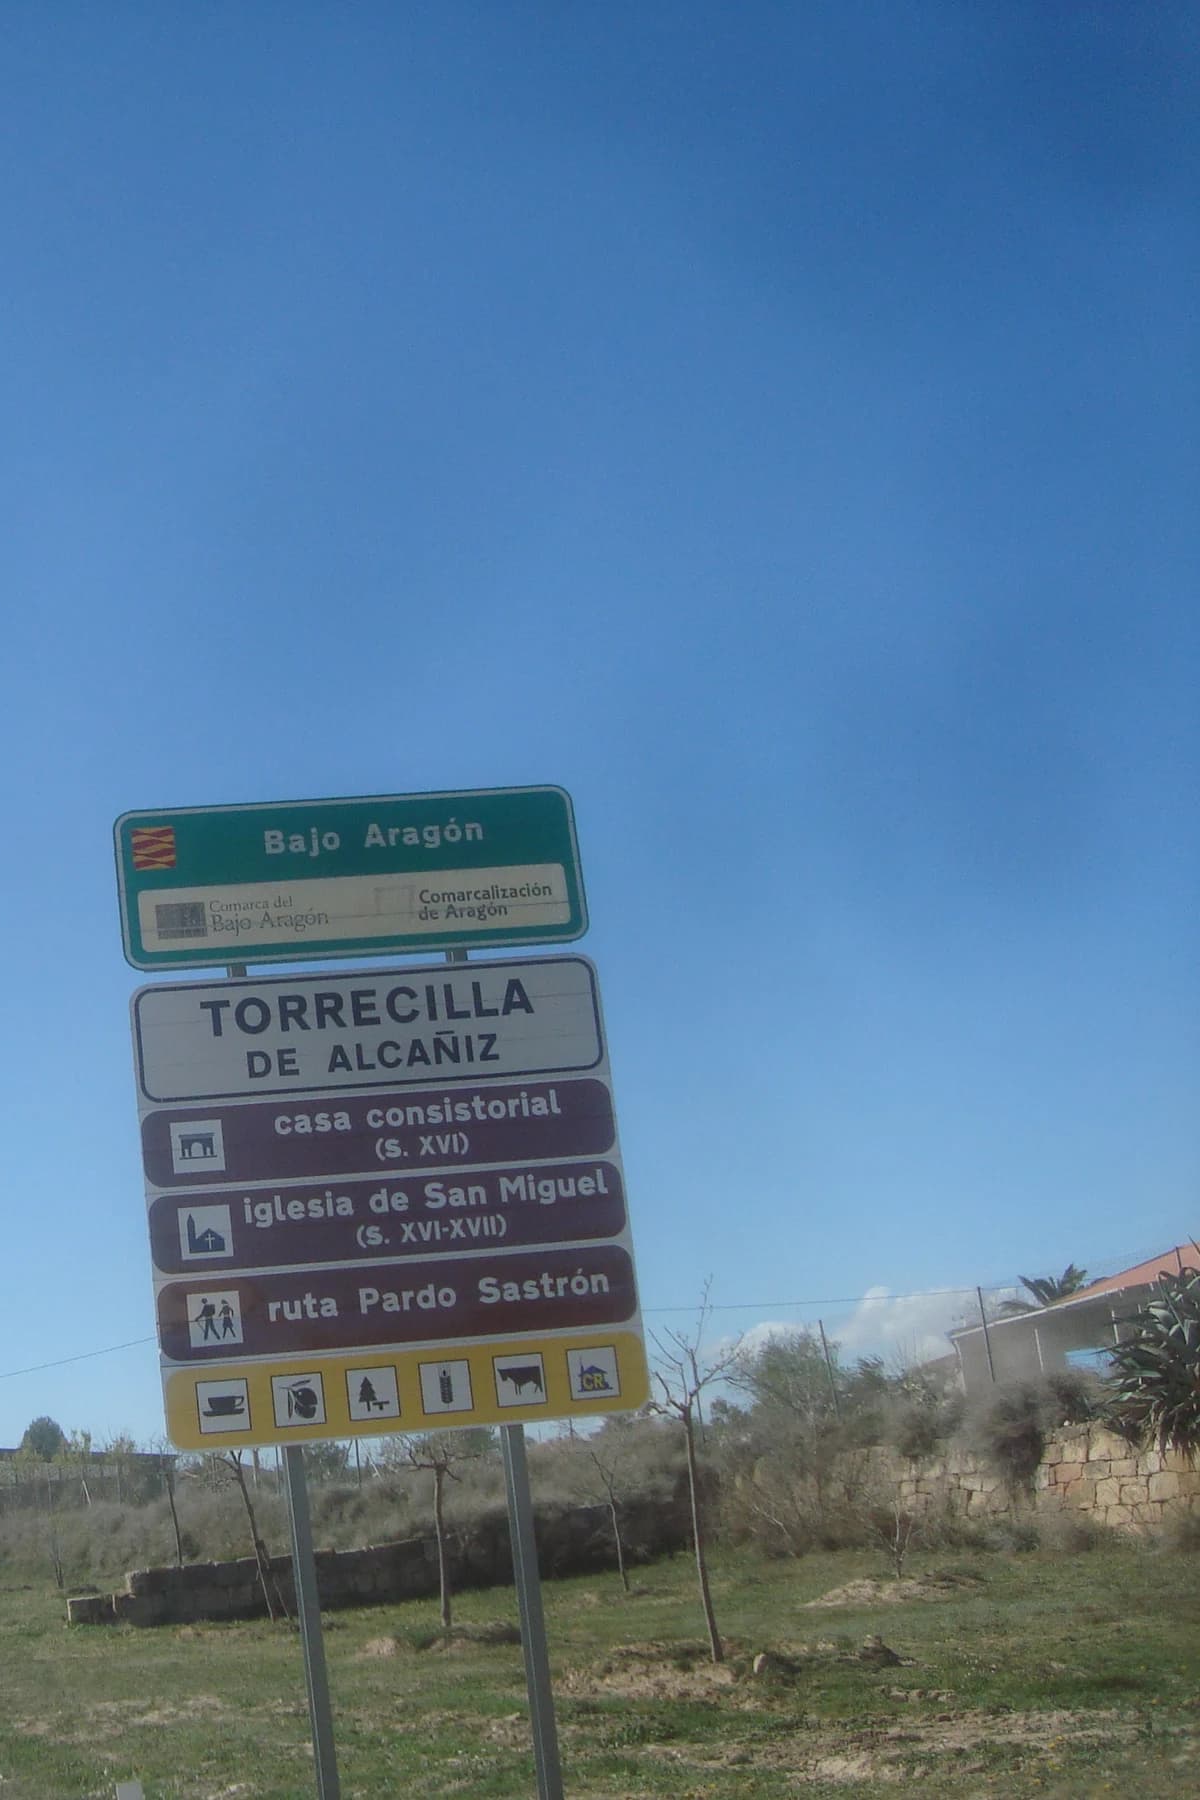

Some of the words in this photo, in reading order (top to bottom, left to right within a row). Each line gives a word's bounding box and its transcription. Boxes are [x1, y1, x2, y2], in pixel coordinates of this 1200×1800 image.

[263, 829, 341, 857] Bajo
[364, 817, 484, 849] Aragón
[209, 899, 270, 913] Comarca
[273, 895, 293, 908] del
[418, 882, 552, 904] Comarcalización
[211, 914, 251, 936] Bajo
[259, 907, 329, 933] Aragón
[418, 907, 439, 921] de
[445, 902, 508, 921] Aragón
[201, 978, 534, 1037] TORRECILLA
[246, 1047, 300, 1079] DE
[327, 1030, 500, 1073] ALCAÑIZ
[274, 1108, 352, 1136] casa
[366, 1089, 562, 1130] consistorial
[419, 1131, 470, 1157] XVI)
[243, 1191, 354, 1228] iglesia
[369, 1187, 409, 1214] de
[424, 1181, 488, 1210] San
[501, 1169, 609, 1204] Miguel
[401, 1214, 508, 1243] XVI-XVII)
[268, 1295, 339, 1322] ruta
[359, 1283, 457, 1314] Pardo
[478, 1267, 610, 1305] Sastrón
